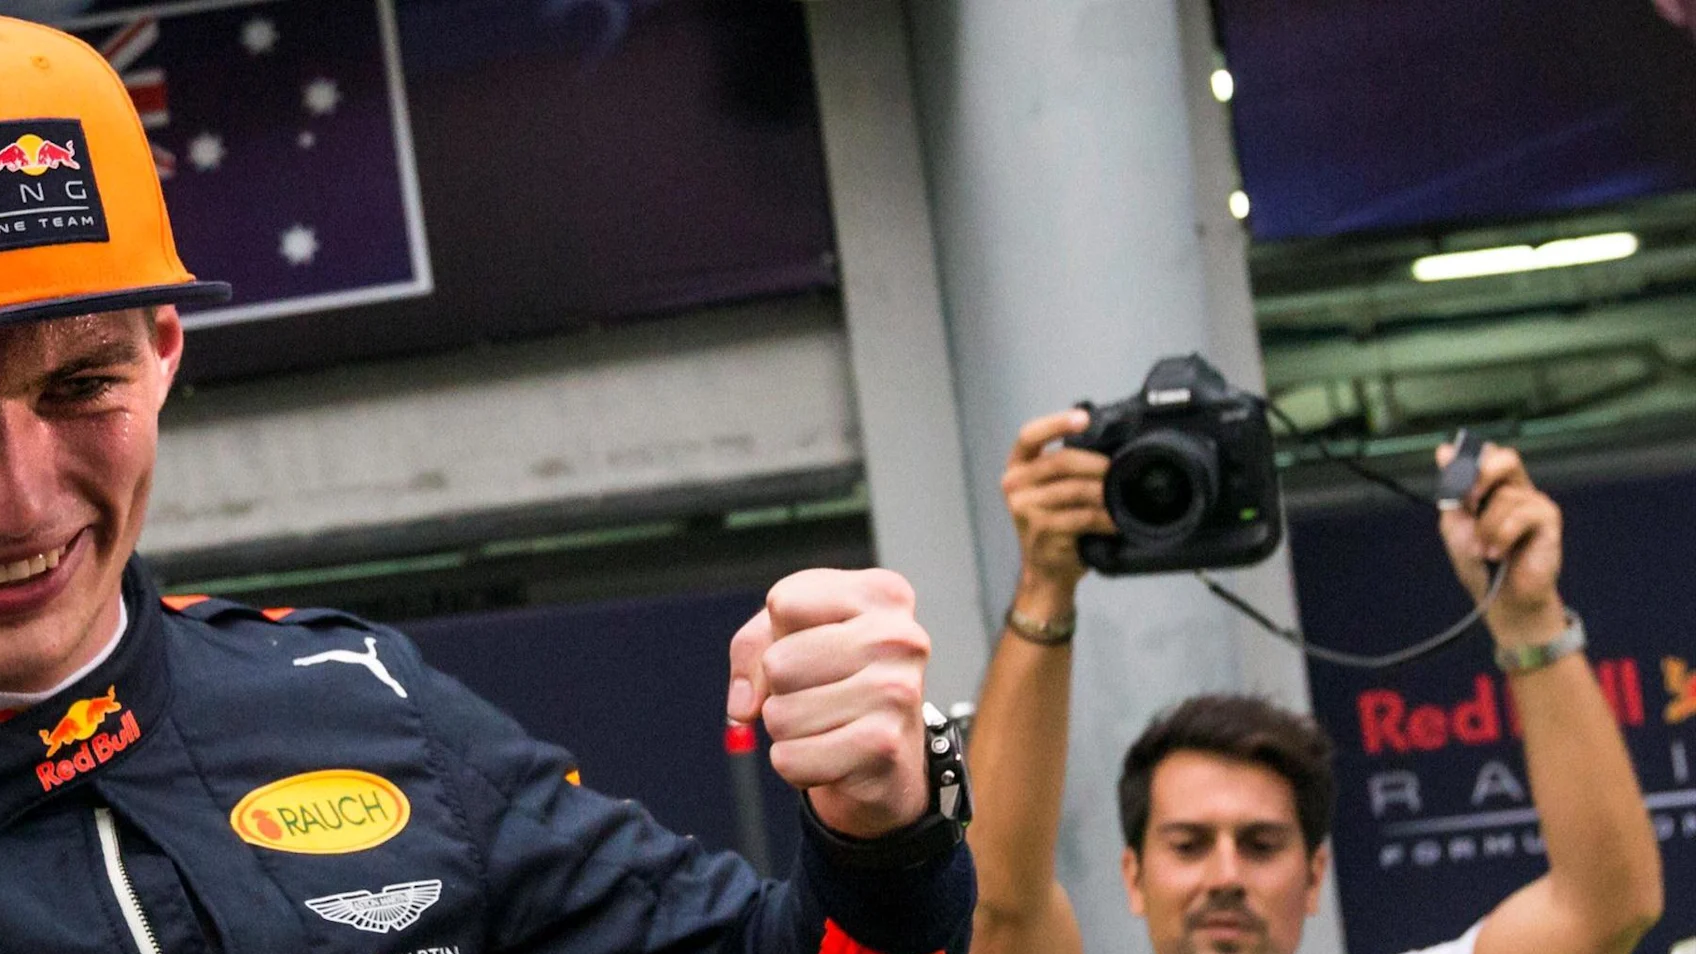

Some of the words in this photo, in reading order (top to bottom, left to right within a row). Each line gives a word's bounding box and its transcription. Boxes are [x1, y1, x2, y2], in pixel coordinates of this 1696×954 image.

[38, 215, 94, 230] TEAM
[1357, 672, 1501, 757] Red
[36, 742, 97, 792] Red
[92, 709, 141, 764] Bull
[275, 791, 389, 835] RAUCH
